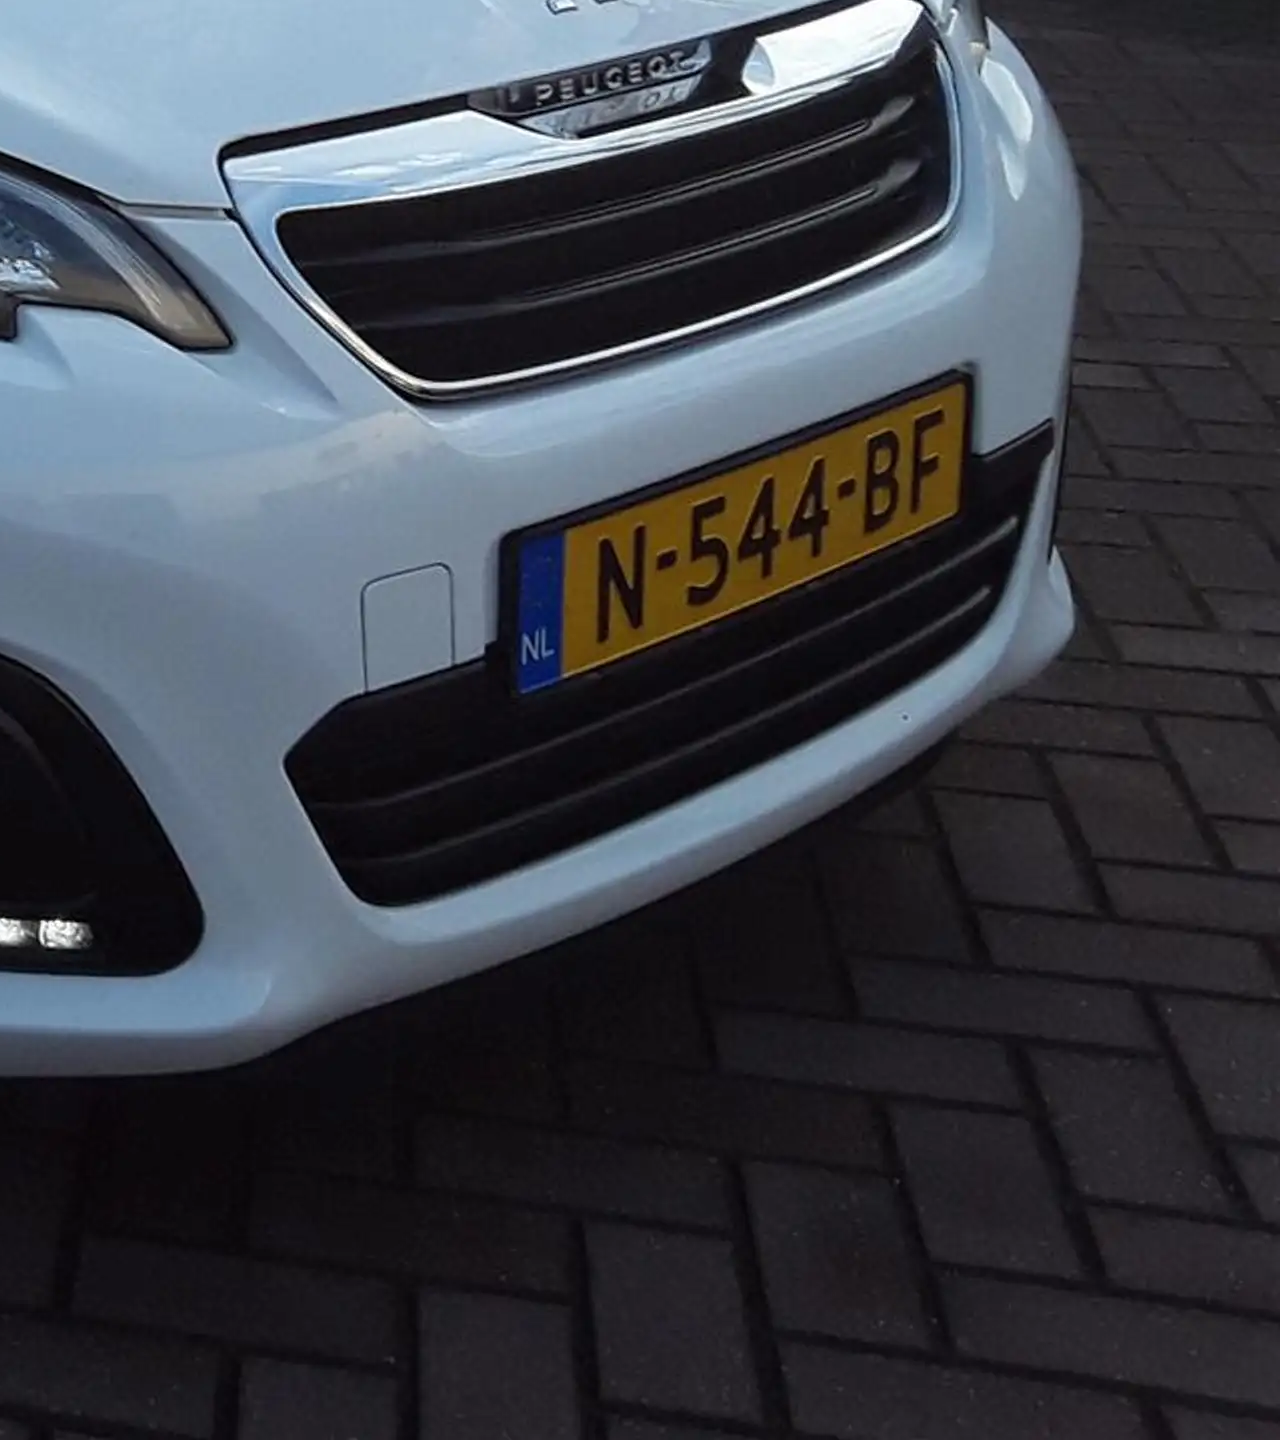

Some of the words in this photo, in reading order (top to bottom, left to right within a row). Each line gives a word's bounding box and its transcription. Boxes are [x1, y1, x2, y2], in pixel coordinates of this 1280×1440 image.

[535, 49, 690, 106] PEUGEOT
[597, 408, 945, 644] N-544-BF
[521, 627, 555, 665] NL
